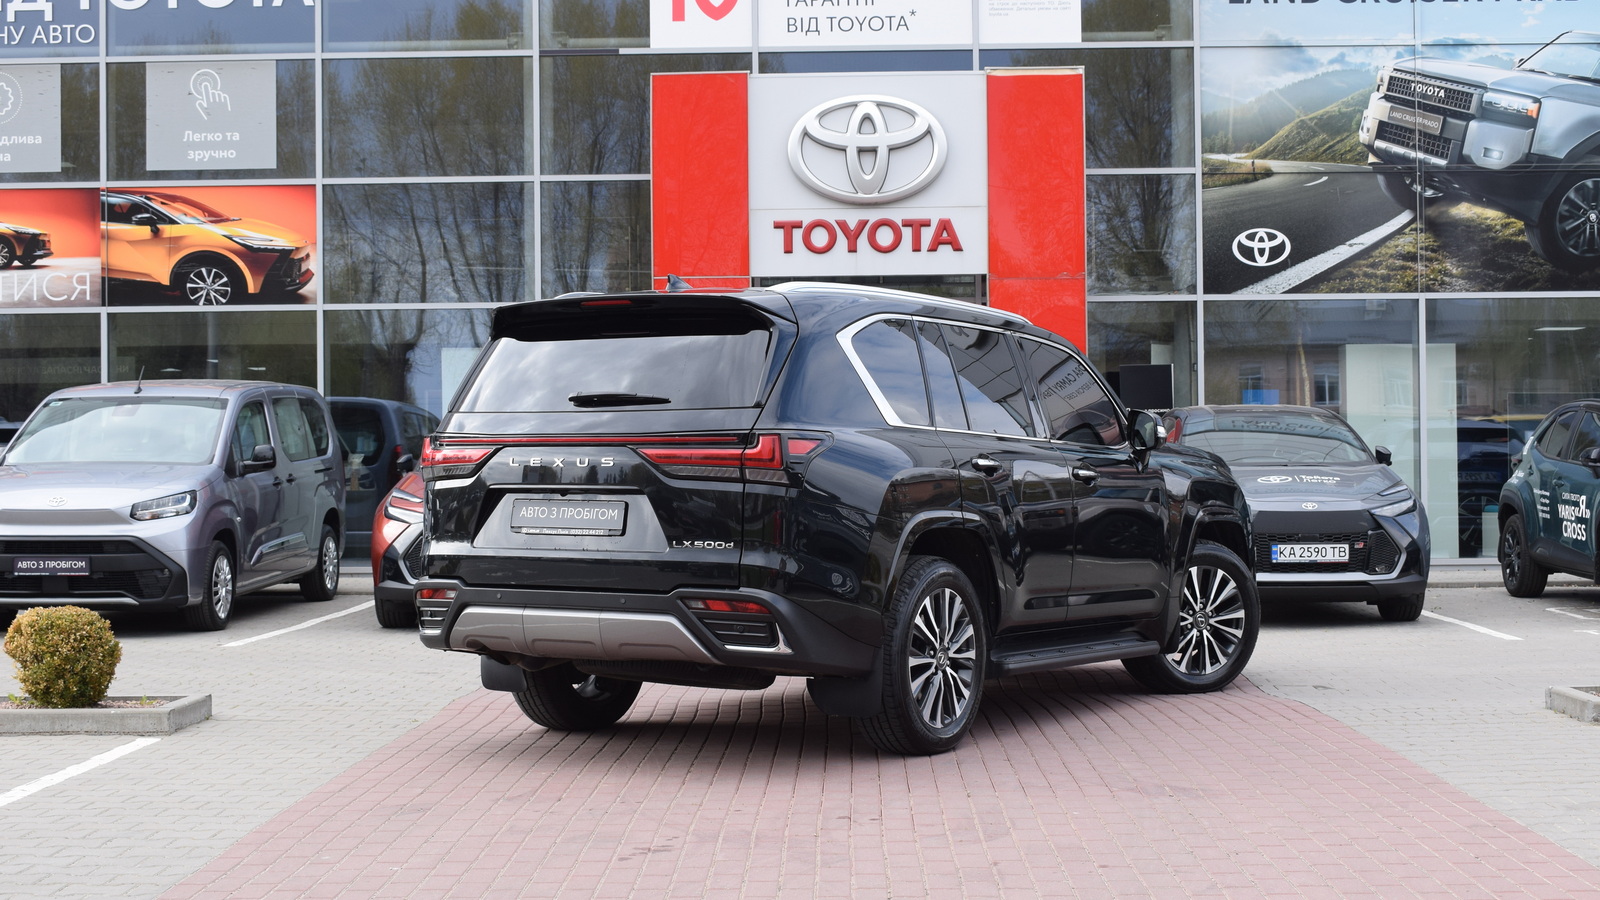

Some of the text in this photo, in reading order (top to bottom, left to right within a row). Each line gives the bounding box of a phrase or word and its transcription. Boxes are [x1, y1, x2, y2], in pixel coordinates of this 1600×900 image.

[786, 17, 821, 36] ВІД
[31, 24, 96, 44] АВТО
[1411, 83, 1445, 98] TOYOTA
[1389, 110, 1402, 119] LAND
[183, 130, 240, 142] Легко та
[187, 149, 237, 162] зручно
[773, 217, 964, 254] TOYOTA
[509, 457, 615, 467] LEXUS
[520, 507, 548, 518] АВТО
[560, 508, 618, 520] ПРОБІГОМ
[1557, 503, 1575, 521] YARIS
[1562, 521, 1586, 541] CROSS
[1279, 546, 1347, 558] KA 2590 TB
[17, 560, 38, 569] АВТО
[45, 560, 86, 569] ПРОБІГОМ
